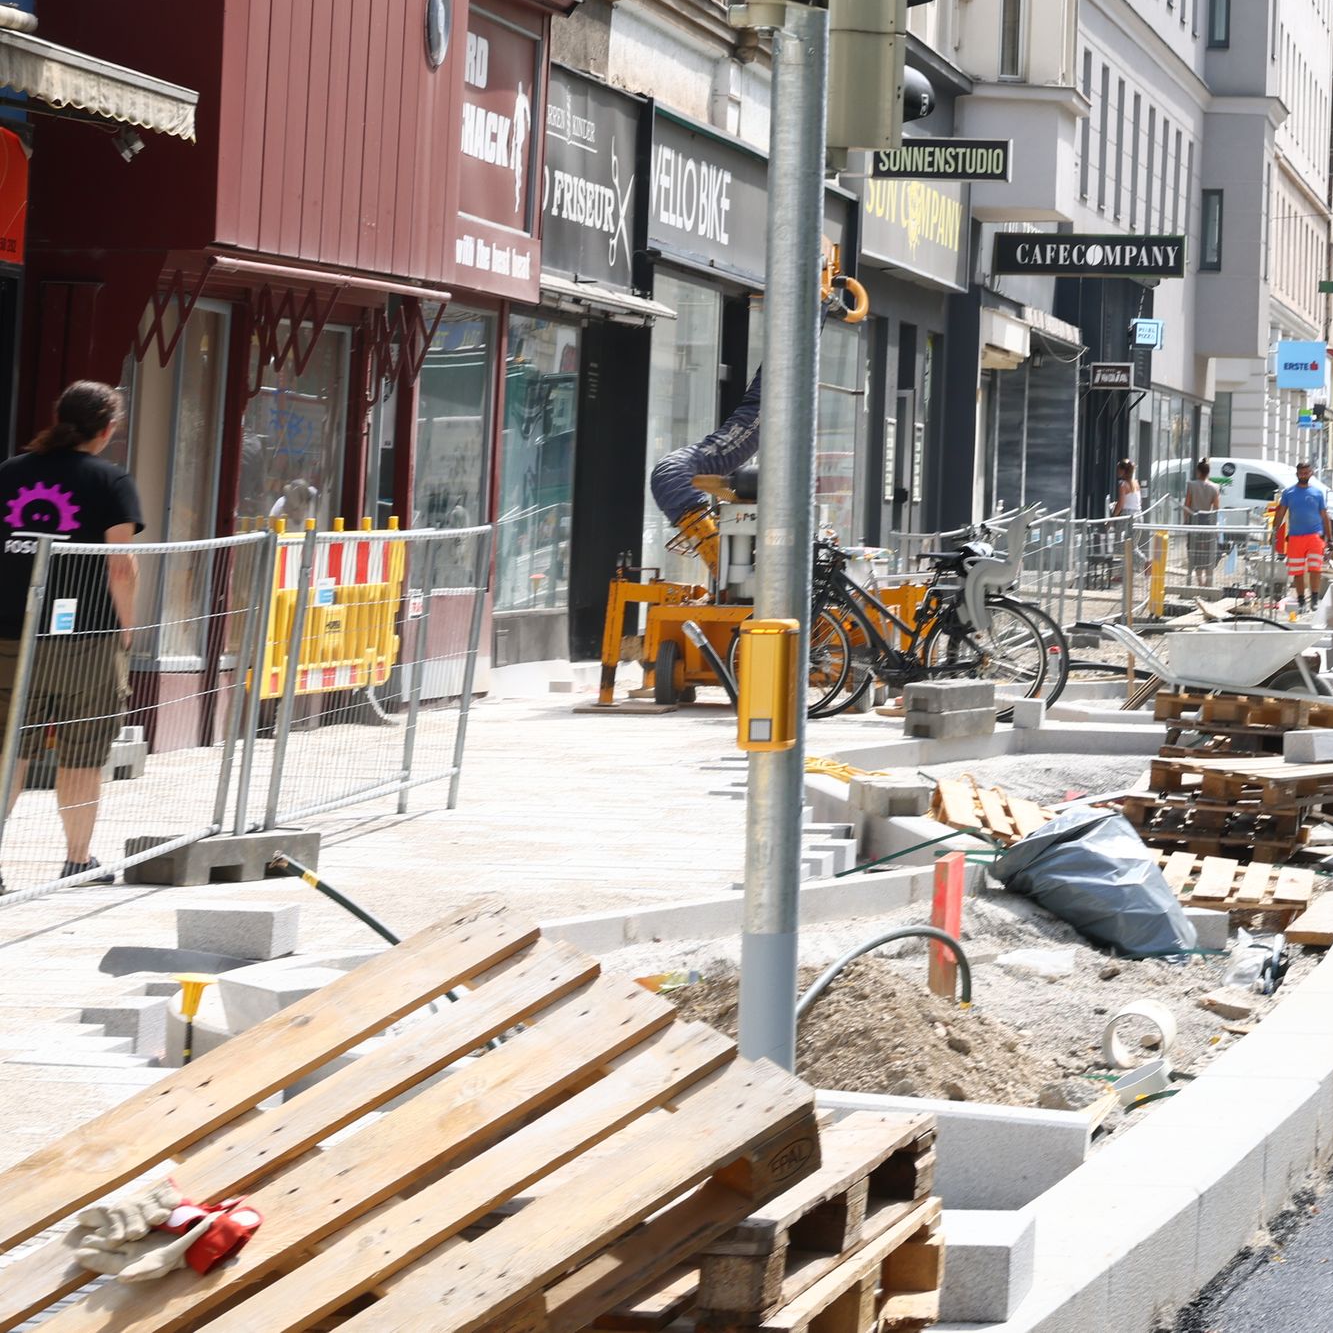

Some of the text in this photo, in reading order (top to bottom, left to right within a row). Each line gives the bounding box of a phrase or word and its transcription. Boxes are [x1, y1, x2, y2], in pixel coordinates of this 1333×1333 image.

[879, 146, 1004, 175] SONNENSTUDIO
[551, 169, 615, 233] FRISEUR
[651, 143, 698, 233] VELLO
[697, 160, 732, 245] BIKE
[1283, 362, 1309, 371] ERSTE
